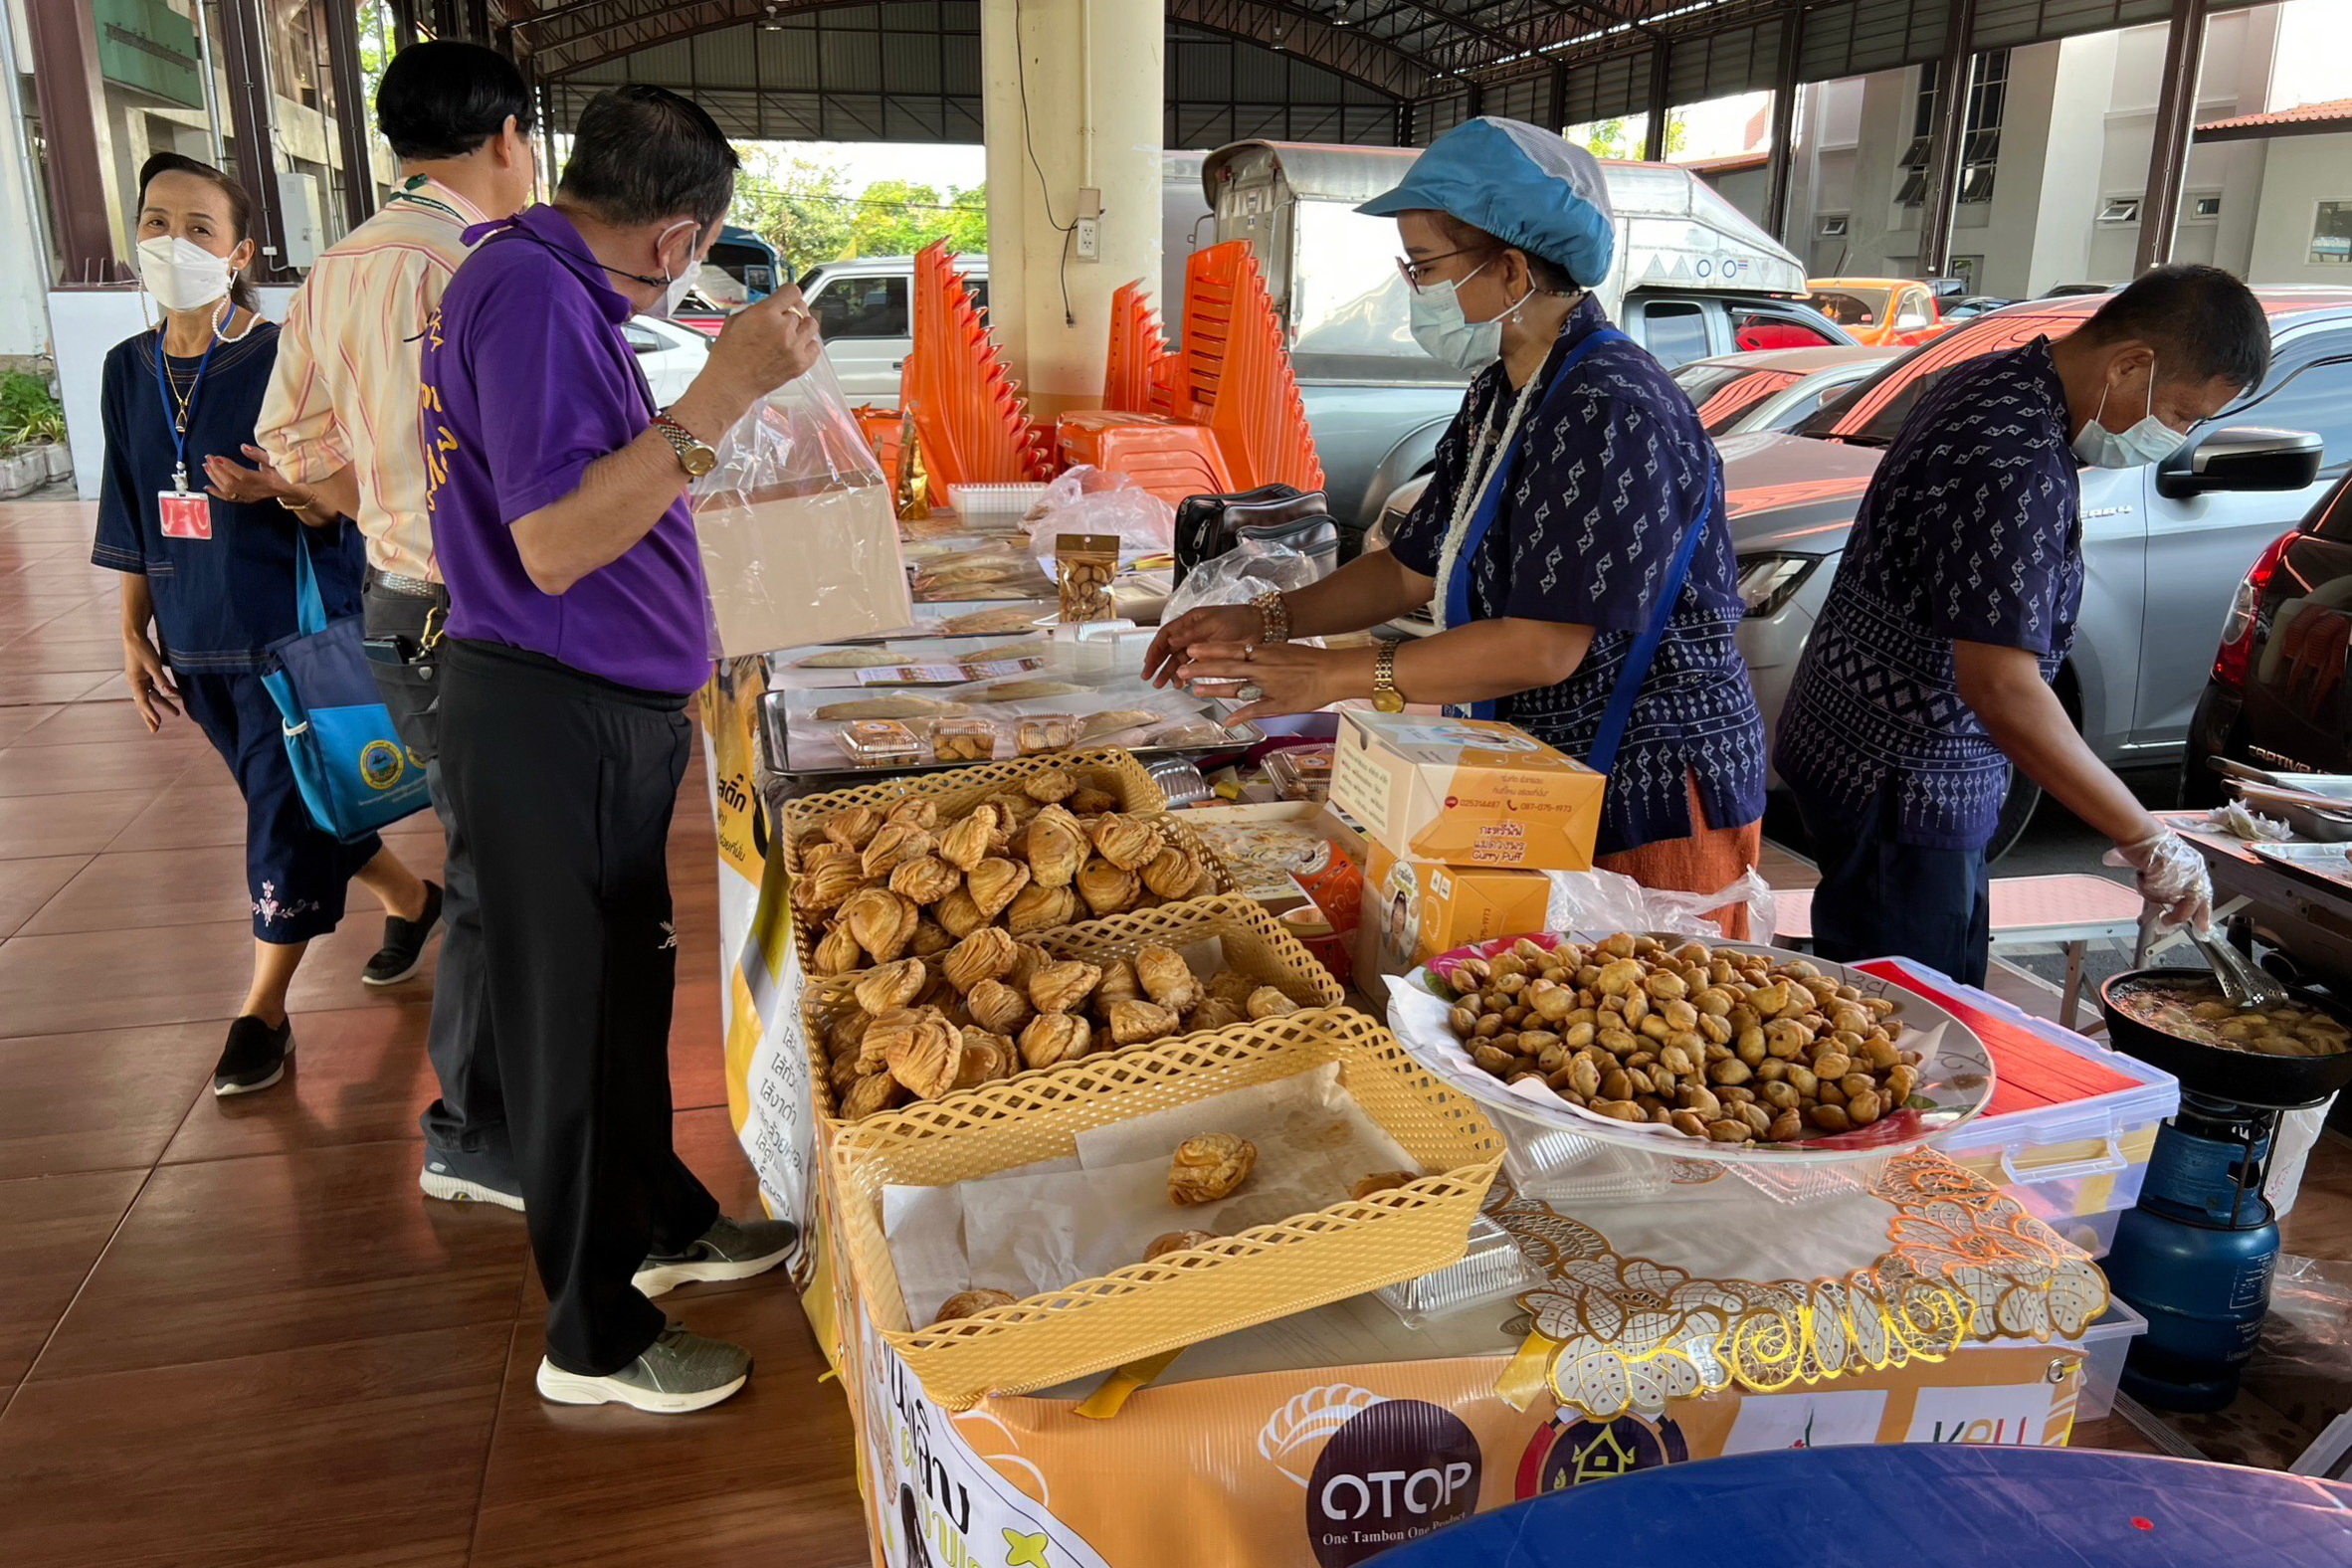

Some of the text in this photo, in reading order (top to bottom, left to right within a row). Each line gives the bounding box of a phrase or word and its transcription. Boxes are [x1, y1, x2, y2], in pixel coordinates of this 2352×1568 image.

[1520, 802, 1572, 813] 087-075-1973
[1471, 851, 1523, 863] Curry Puff
[759, 1078, 798, 1127] ไส้งาดำ
[1321, 1462, 1472, 1520] OTOP
[1322, 1532, 1348, 1545] One
[1352, 1529, 1404, 1544] Tambon
